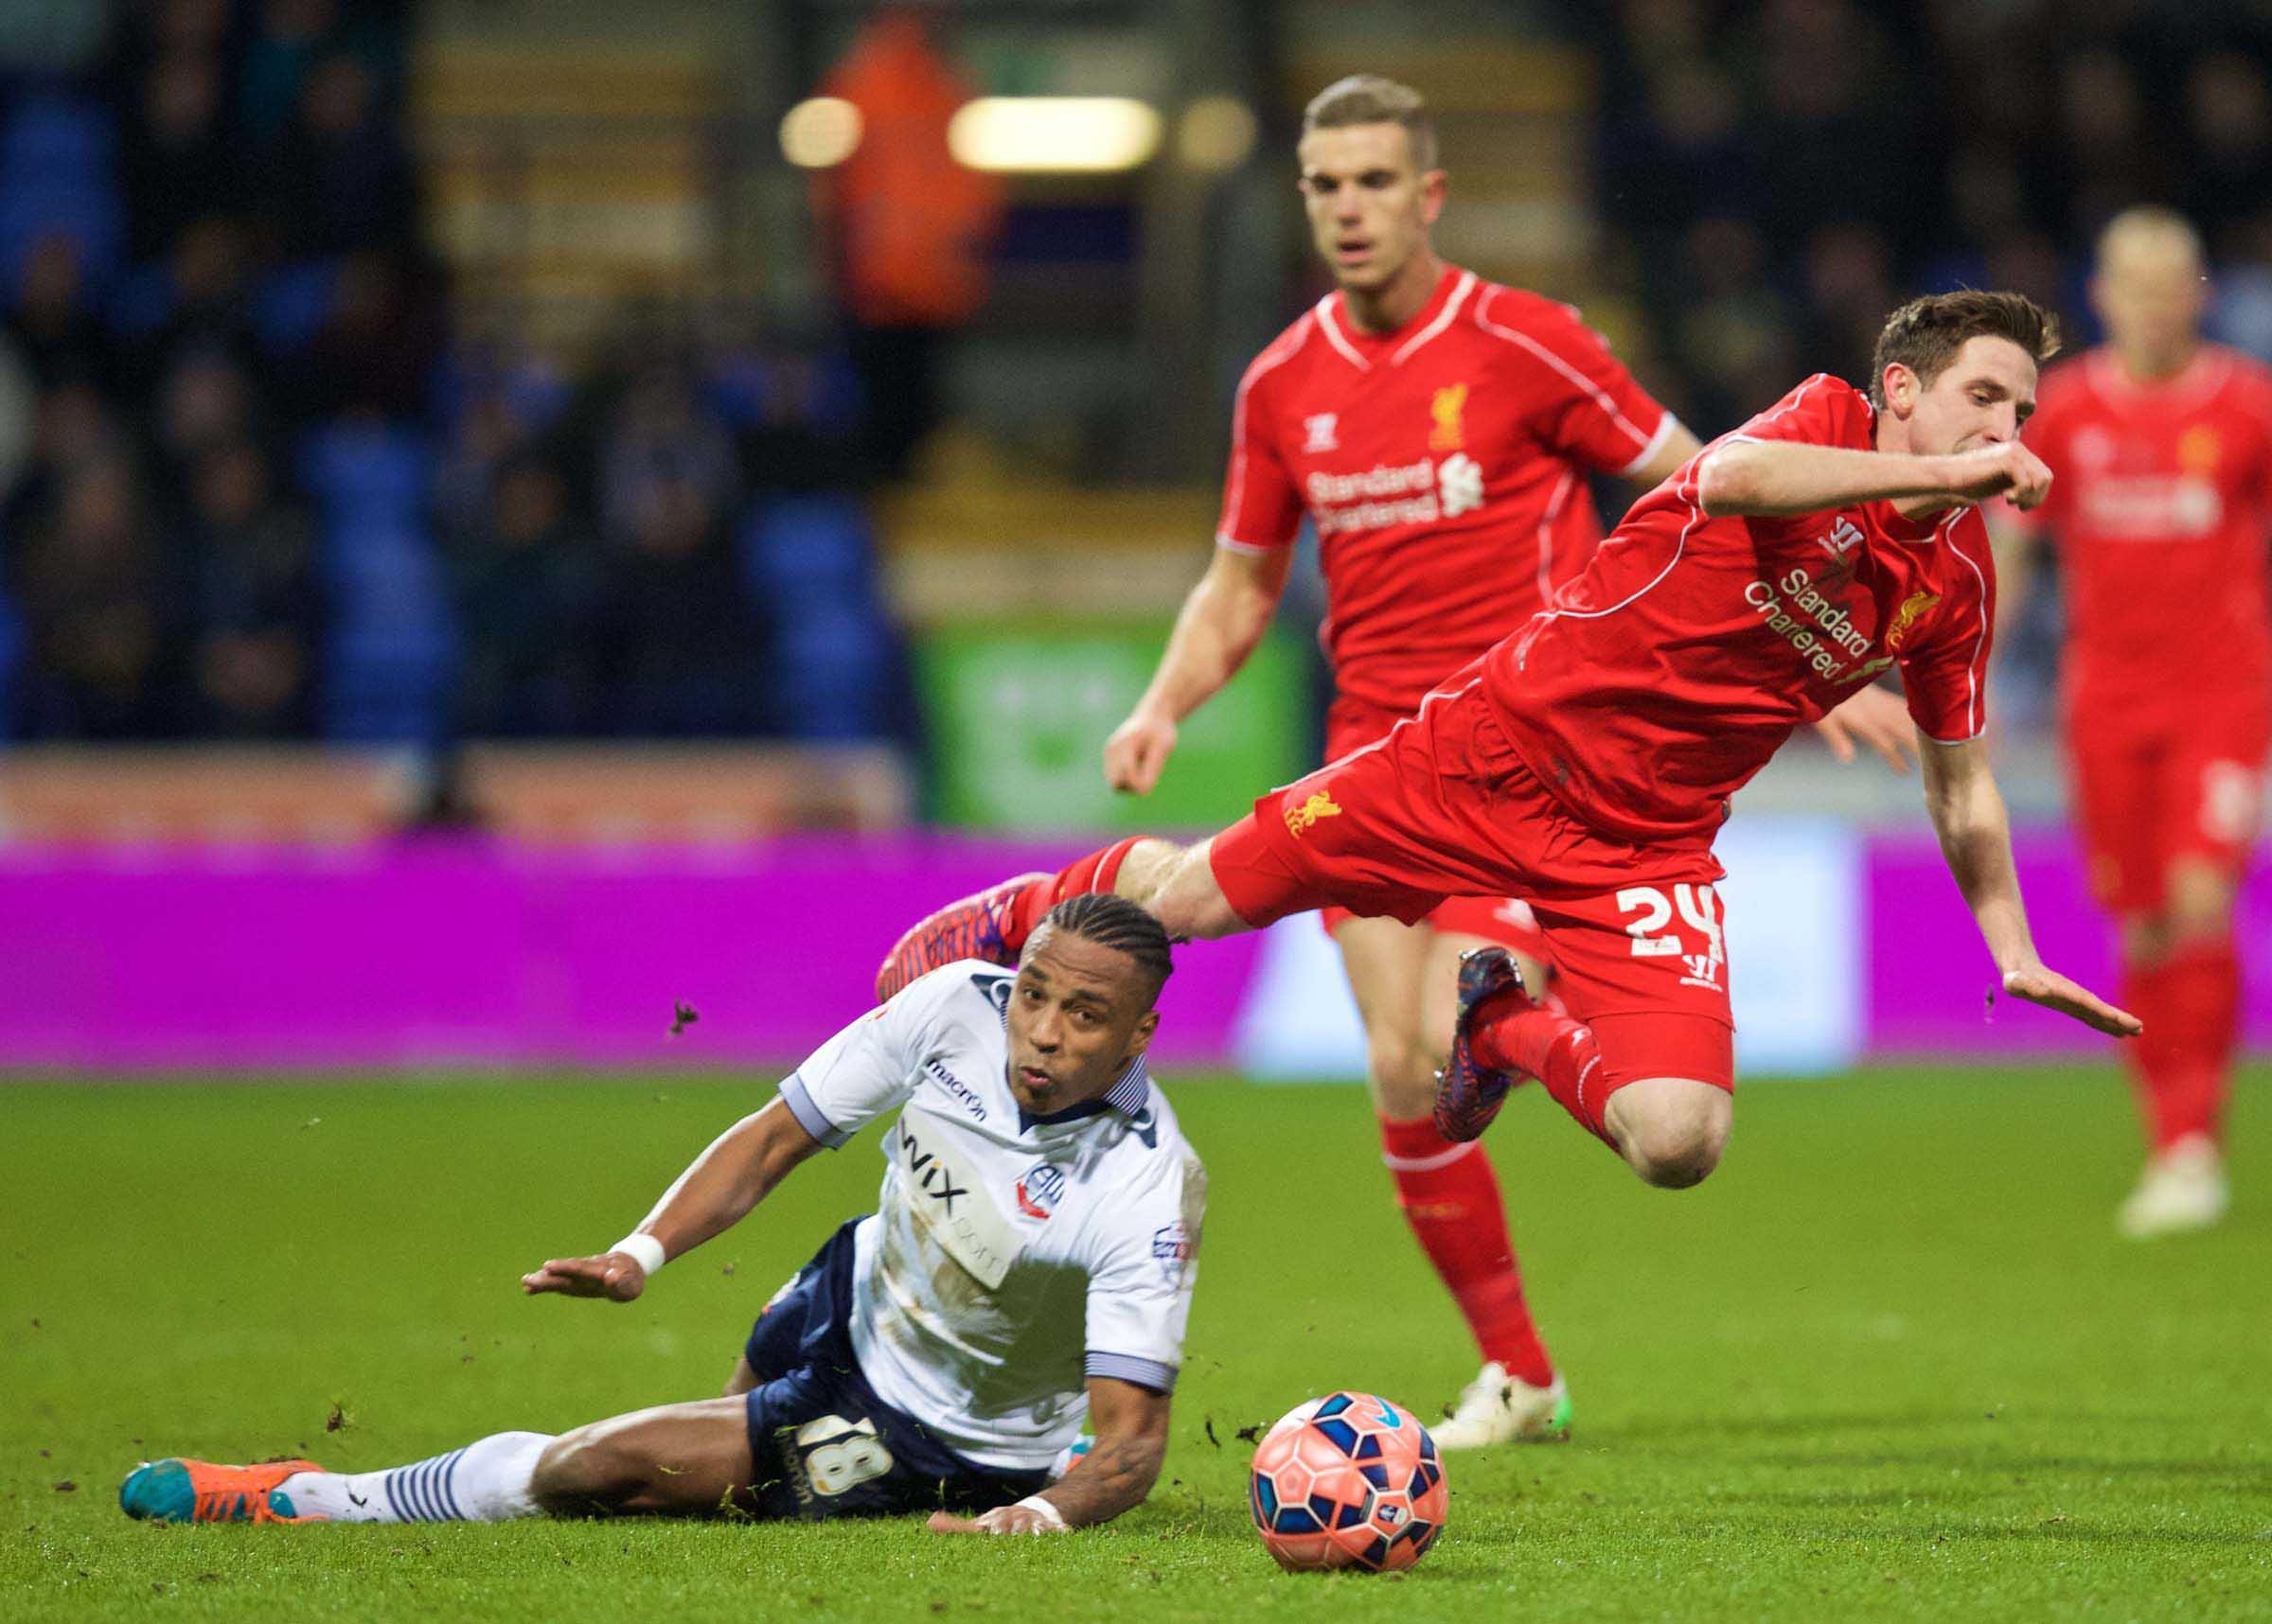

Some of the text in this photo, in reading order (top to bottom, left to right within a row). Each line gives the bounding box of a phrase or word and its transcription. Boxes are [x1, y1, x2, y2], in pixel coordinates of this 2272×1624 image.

[1781, 569, 1875, 658] Standard
[1616, 883, 1724, 963] 24
[927, 1058, 986, 1122] macron
[797, 1414, 894, 1496] 18
